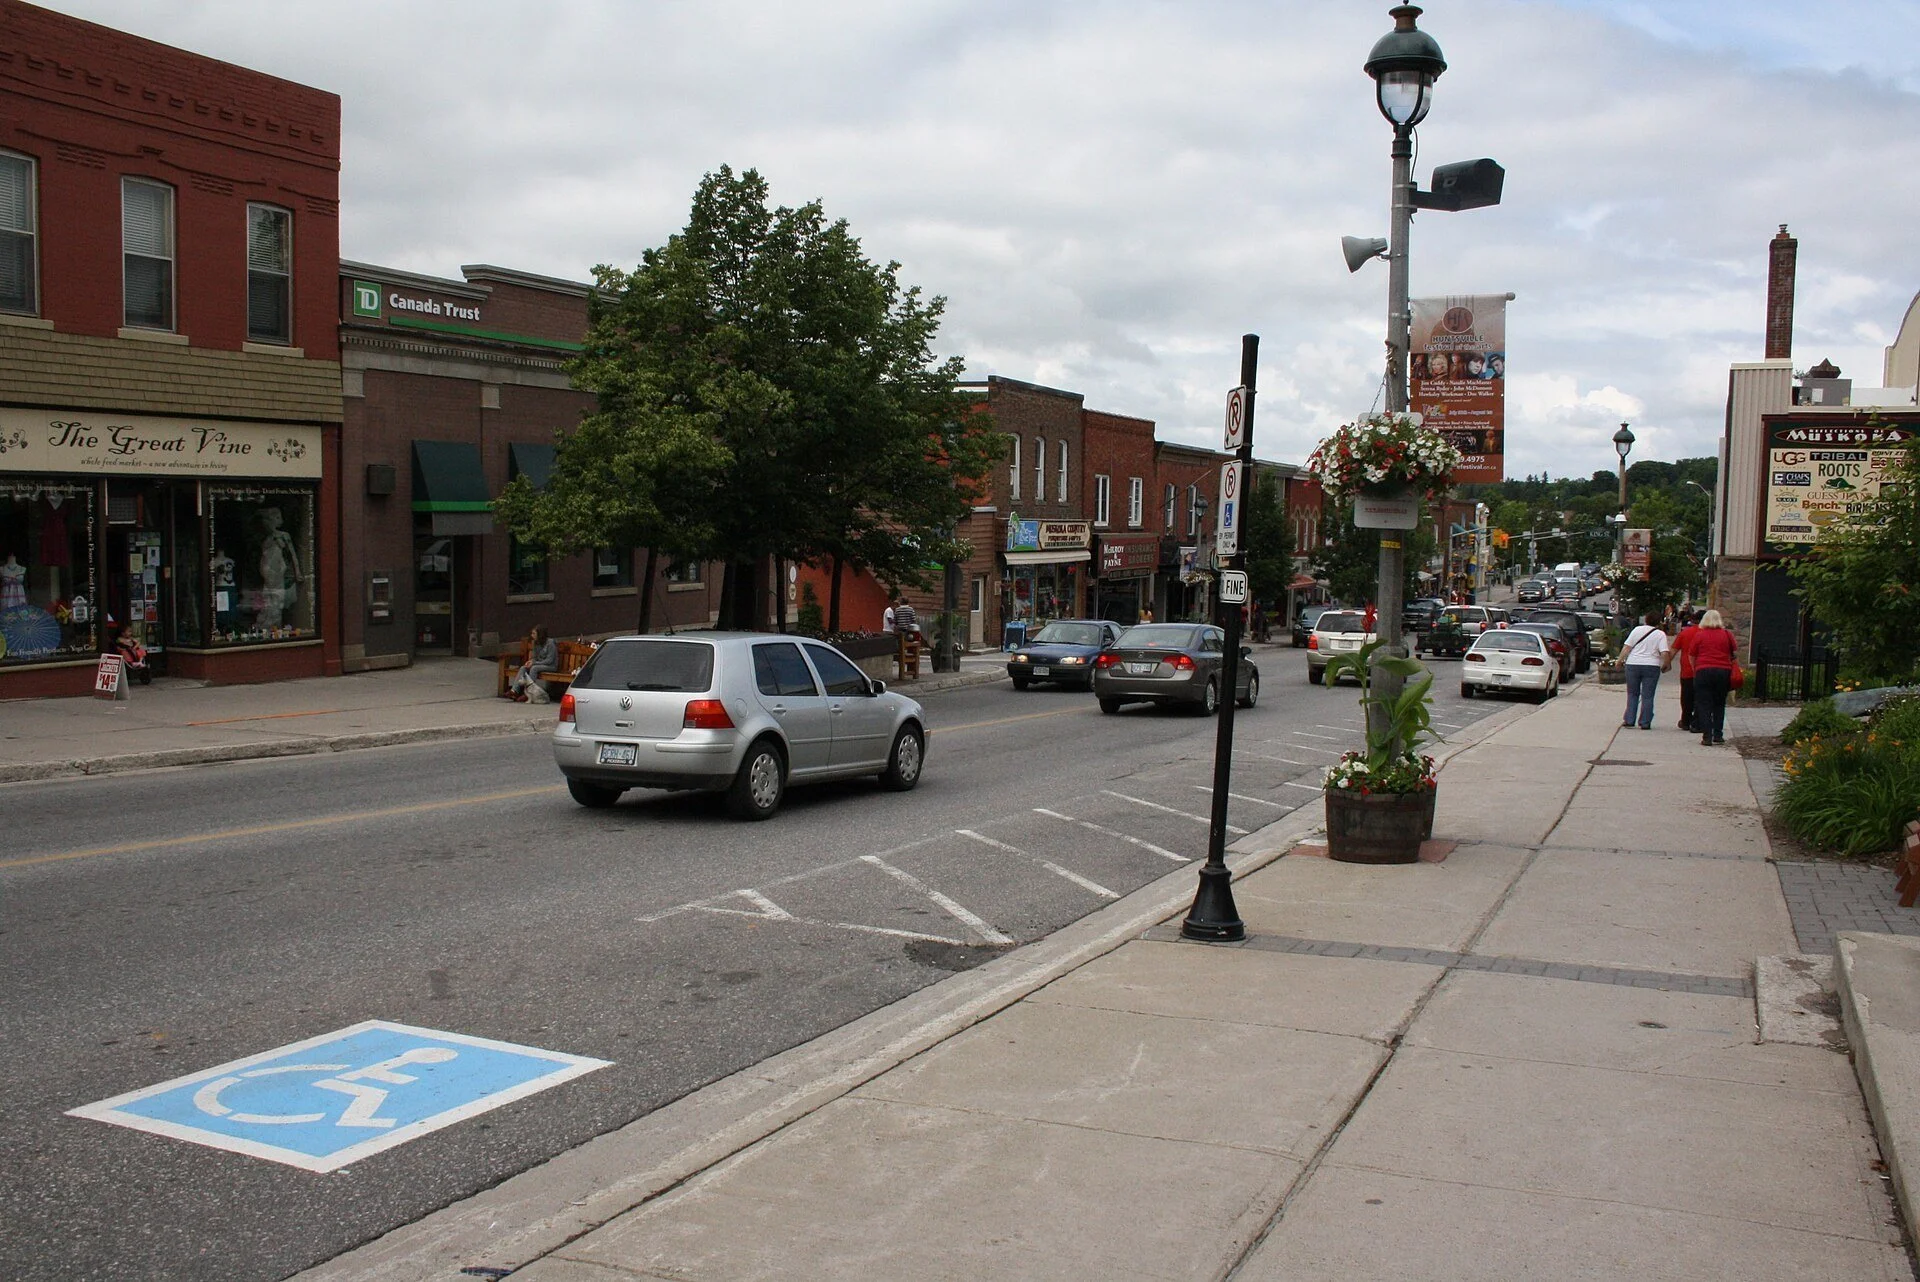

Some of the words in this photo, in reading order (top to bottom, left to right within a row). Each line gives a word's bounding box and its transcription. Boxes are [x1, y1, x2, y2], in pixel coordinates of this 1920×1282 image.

[357, 287, 379, 311] TD
[389, 293, 441, 315] Canada
[443, 301, 481, 321] Trust
[1432, 334, 1484, 343] HUNTSVILLE
[1423, 343, 1454, 351] festival
[48, 420, 98, 449] The
[106, 424, 185, 455] Great
[190, 426, 252, 455] Vine
[1786, 429, 1902, 442] MUSKOKA
[118, 457, 141, 466] market
[1774, 452, 1806, 465] UGG
[1811, 453, 1866, 461] TRIBAL
[1818, 463, 1860, 477] ROOTS
[1786, 473, 1810, 481] CHAPS
[1807, 492, 1839, 500] GUESS
[1802, 500, 1842, 510] Bench.
[1045, 524, 1067, 534] MUSKOKA
[1223, 531, 1235, 540] PERMIT
[1770, 533, 1798, 541] Calvin
[1801, 533, 1817, 541] Kle
[1222, 540, 1231, 549] ONLY
[1103, 558, 1122, 570] PAYNE
[1225, 579, 1244, 596] FINE
